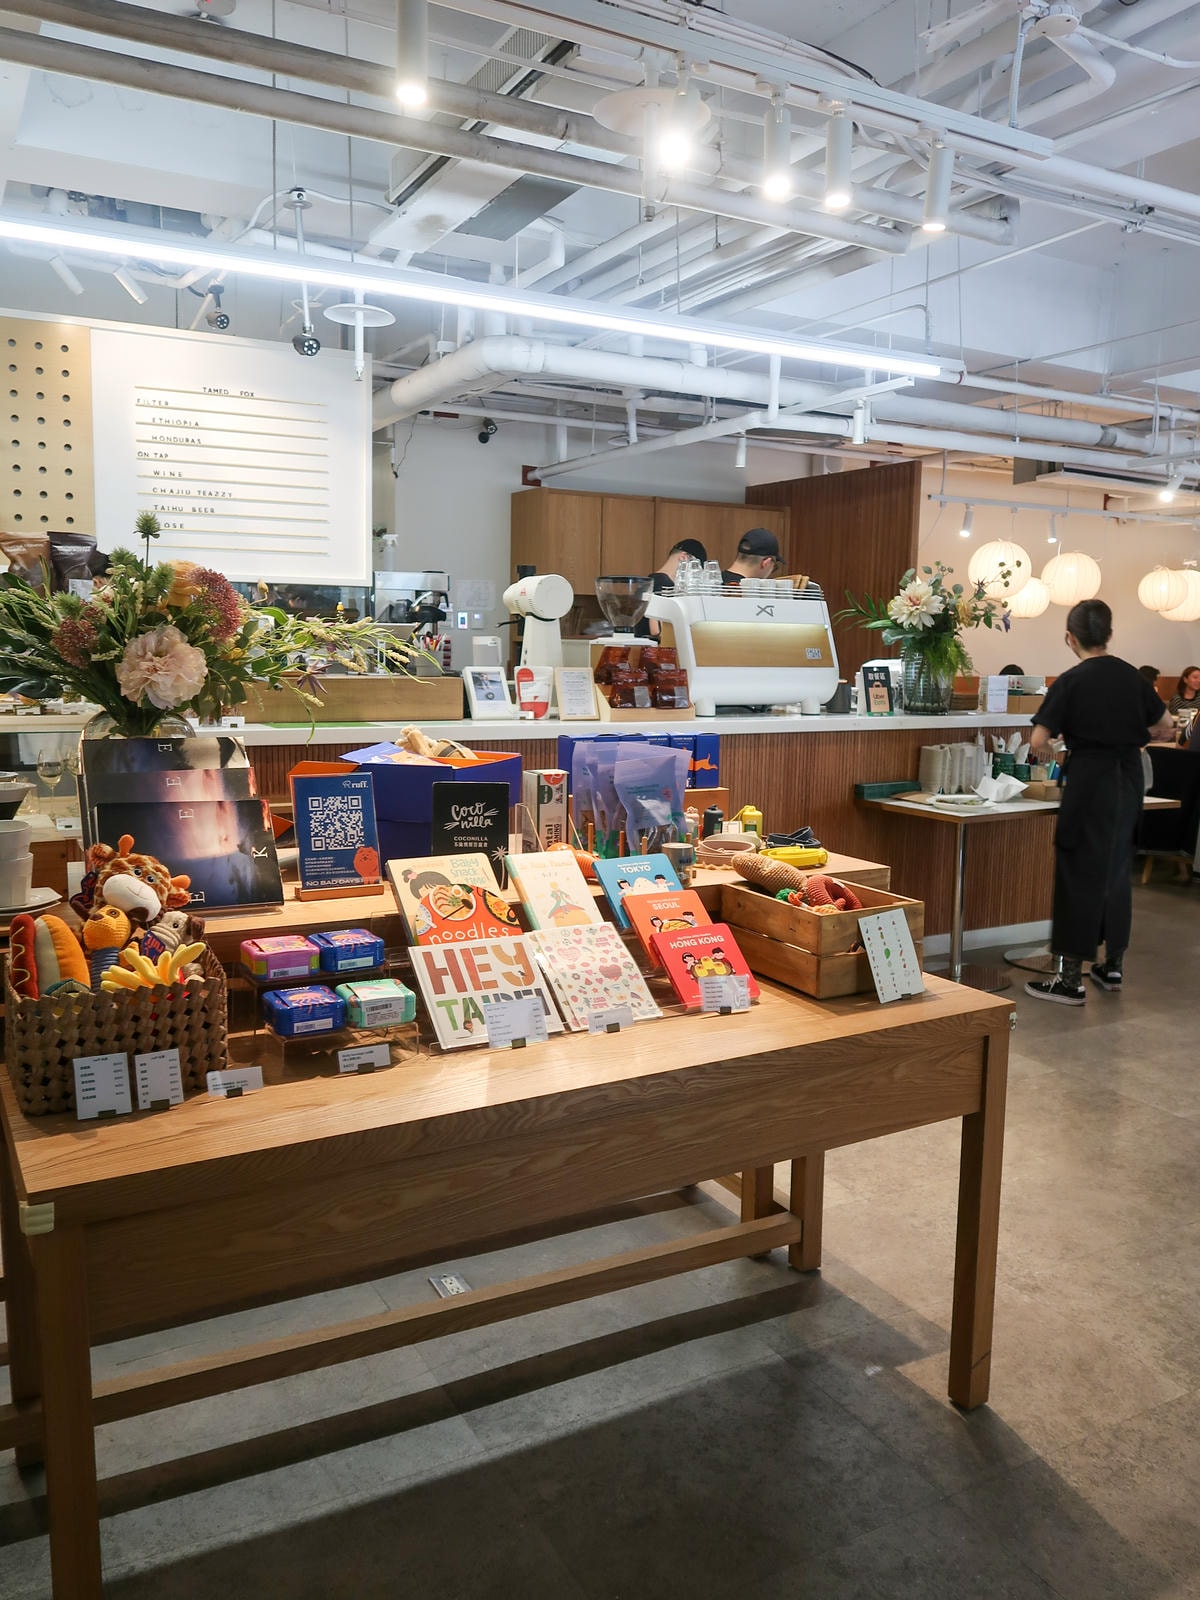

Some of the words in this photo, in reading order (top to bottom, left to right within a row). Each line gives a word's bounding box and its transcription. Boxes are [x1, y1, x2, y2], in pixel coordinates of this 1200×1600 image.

[203, 387, 230, 395] TAMED
[240, 390, 255, 398] FOX
[136, 398, 169, 406] FILTER
[152, 417, 200, 426] ETHIOPIA
[152, 435, 201, 444] HONDURAS
[153, 470, 182, 478] WINE
[152, 487, 191, 495] CHAJIU
[197, 490, 233, 498] TEAZZY
[154, 504, 184, 512] TAIHU
[451, 802, 486, 821] Coco
[460, 815, 493, 829] nilla
[620, 864, 652, 874] TOKYO
[652, 901, 681, 910] SEOUL
[429, 921, 510, 945] noodles
[669, 938, 698, 949] HONG
[698, 934, 725, 945] KONG
[421, 942, 536, 995] HEY
